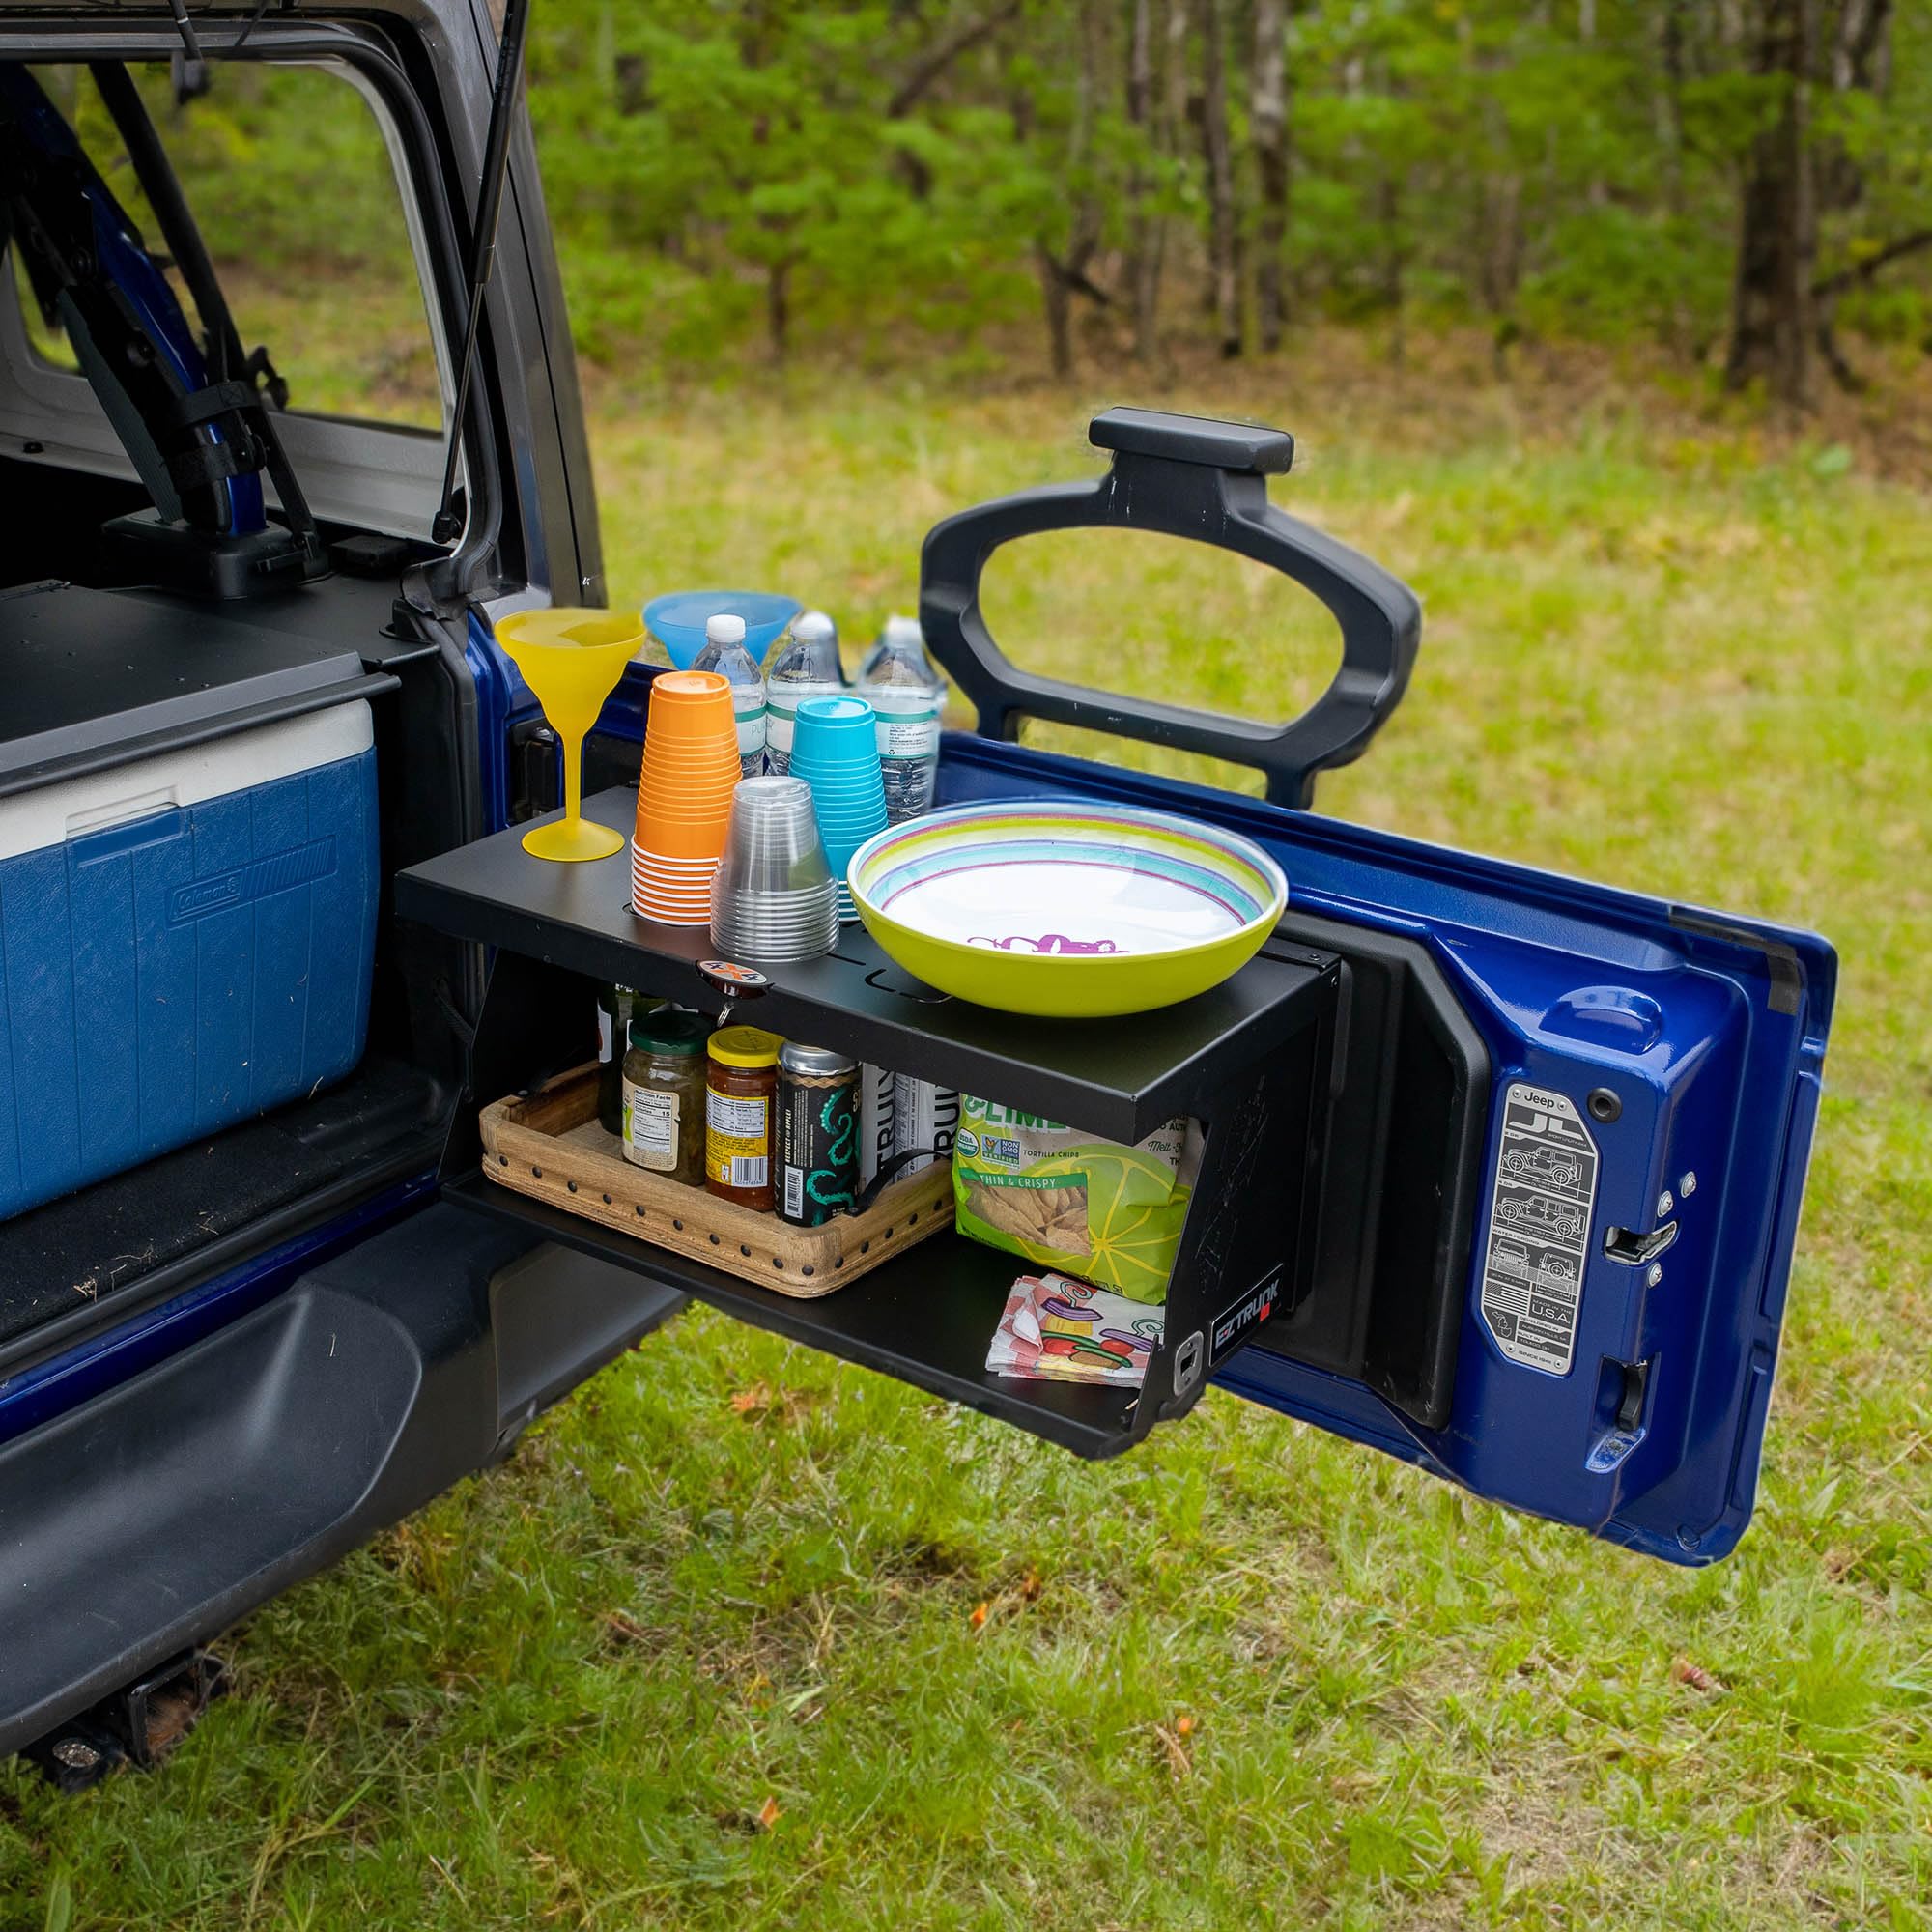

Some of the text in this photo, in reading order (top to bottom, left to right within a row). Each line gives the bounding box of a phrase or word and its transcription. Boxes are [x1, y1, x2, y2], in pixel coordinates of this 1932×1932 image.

[1524, 1092, 1555, 1109] Jeep
[1508, 1112, 1584, 1141] JL
[1002, 1140, 1019, 1149] NON
[1002, 1146, 1019, 1154] GMO
[1023, 1150, 1055, 1158] TORTILLA
[980, 1175, 1056, 1189] THIN & CRISPY
[1215, 1278, 1280, 1350] EZTRUNK
[1531, 1303, 1571, 1324] U.S.A.
